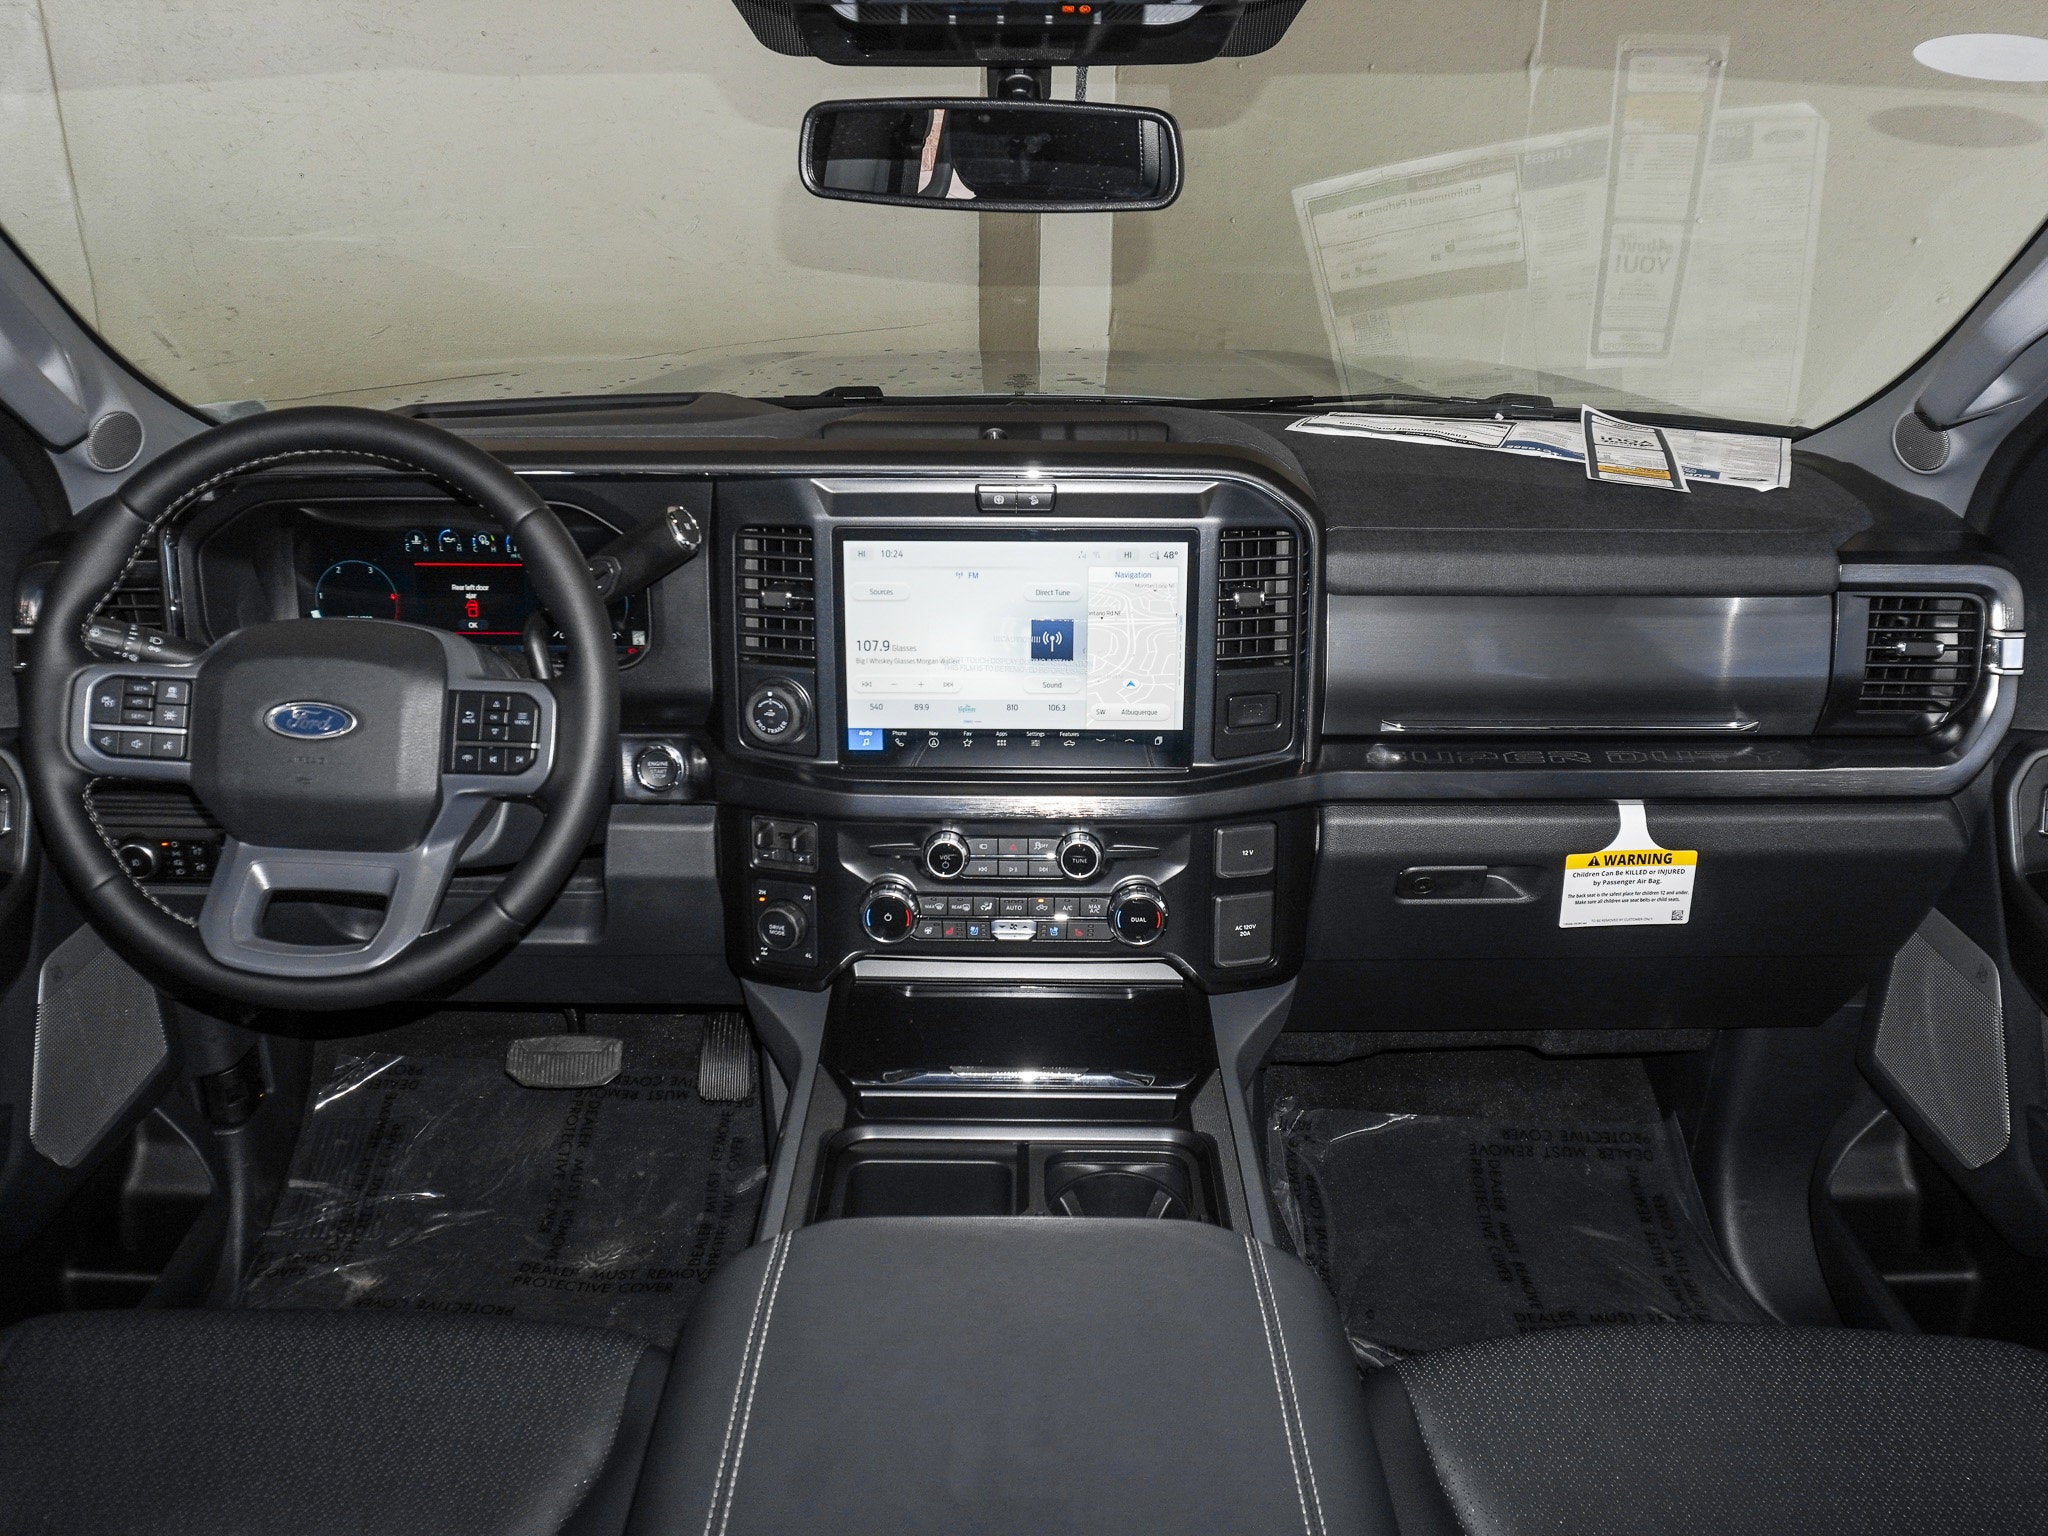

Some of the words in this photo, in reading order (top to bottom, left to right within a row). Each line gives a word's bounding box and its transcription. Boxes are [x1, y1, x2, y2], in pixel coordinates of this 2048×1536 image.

[881, 550, 903, 558] 10:24
[1163, 550, 1178, 559] 48°
[1115, 571, 1152, 579] Navigation
[869, 588, 894, 596] Sources
[856, 640, 890, 652] 107.9
[1048, 704, 1066, 712] 106.3
[1096, 708, 1106, 716] SW
[1121, 708, 1158, 717] Albuquerque
[756, 720, 766, 731] PRO
[767, 720, 788, 734] TRAILER
[1604, 853, 1673, 866] WARNING
[1658, 868, 1686, 876] INJURED
[1592, 880, 1601, 888] by
[1062, 904, 1073, 912] A/C
[577, 1100, 601, 1149] DEALER
[1501, 1128, 1552, 1141] COVER
[1560, 1130, 1651, 1144] PROTECTIVE
[1543, 1146, 1586, 1159] MUST
[1597, 1148, 1654, 1162] DEALER
[512, 1275, 611, 1294] PROTECTIVE
[619, 1282, 673, 1294] COVER
